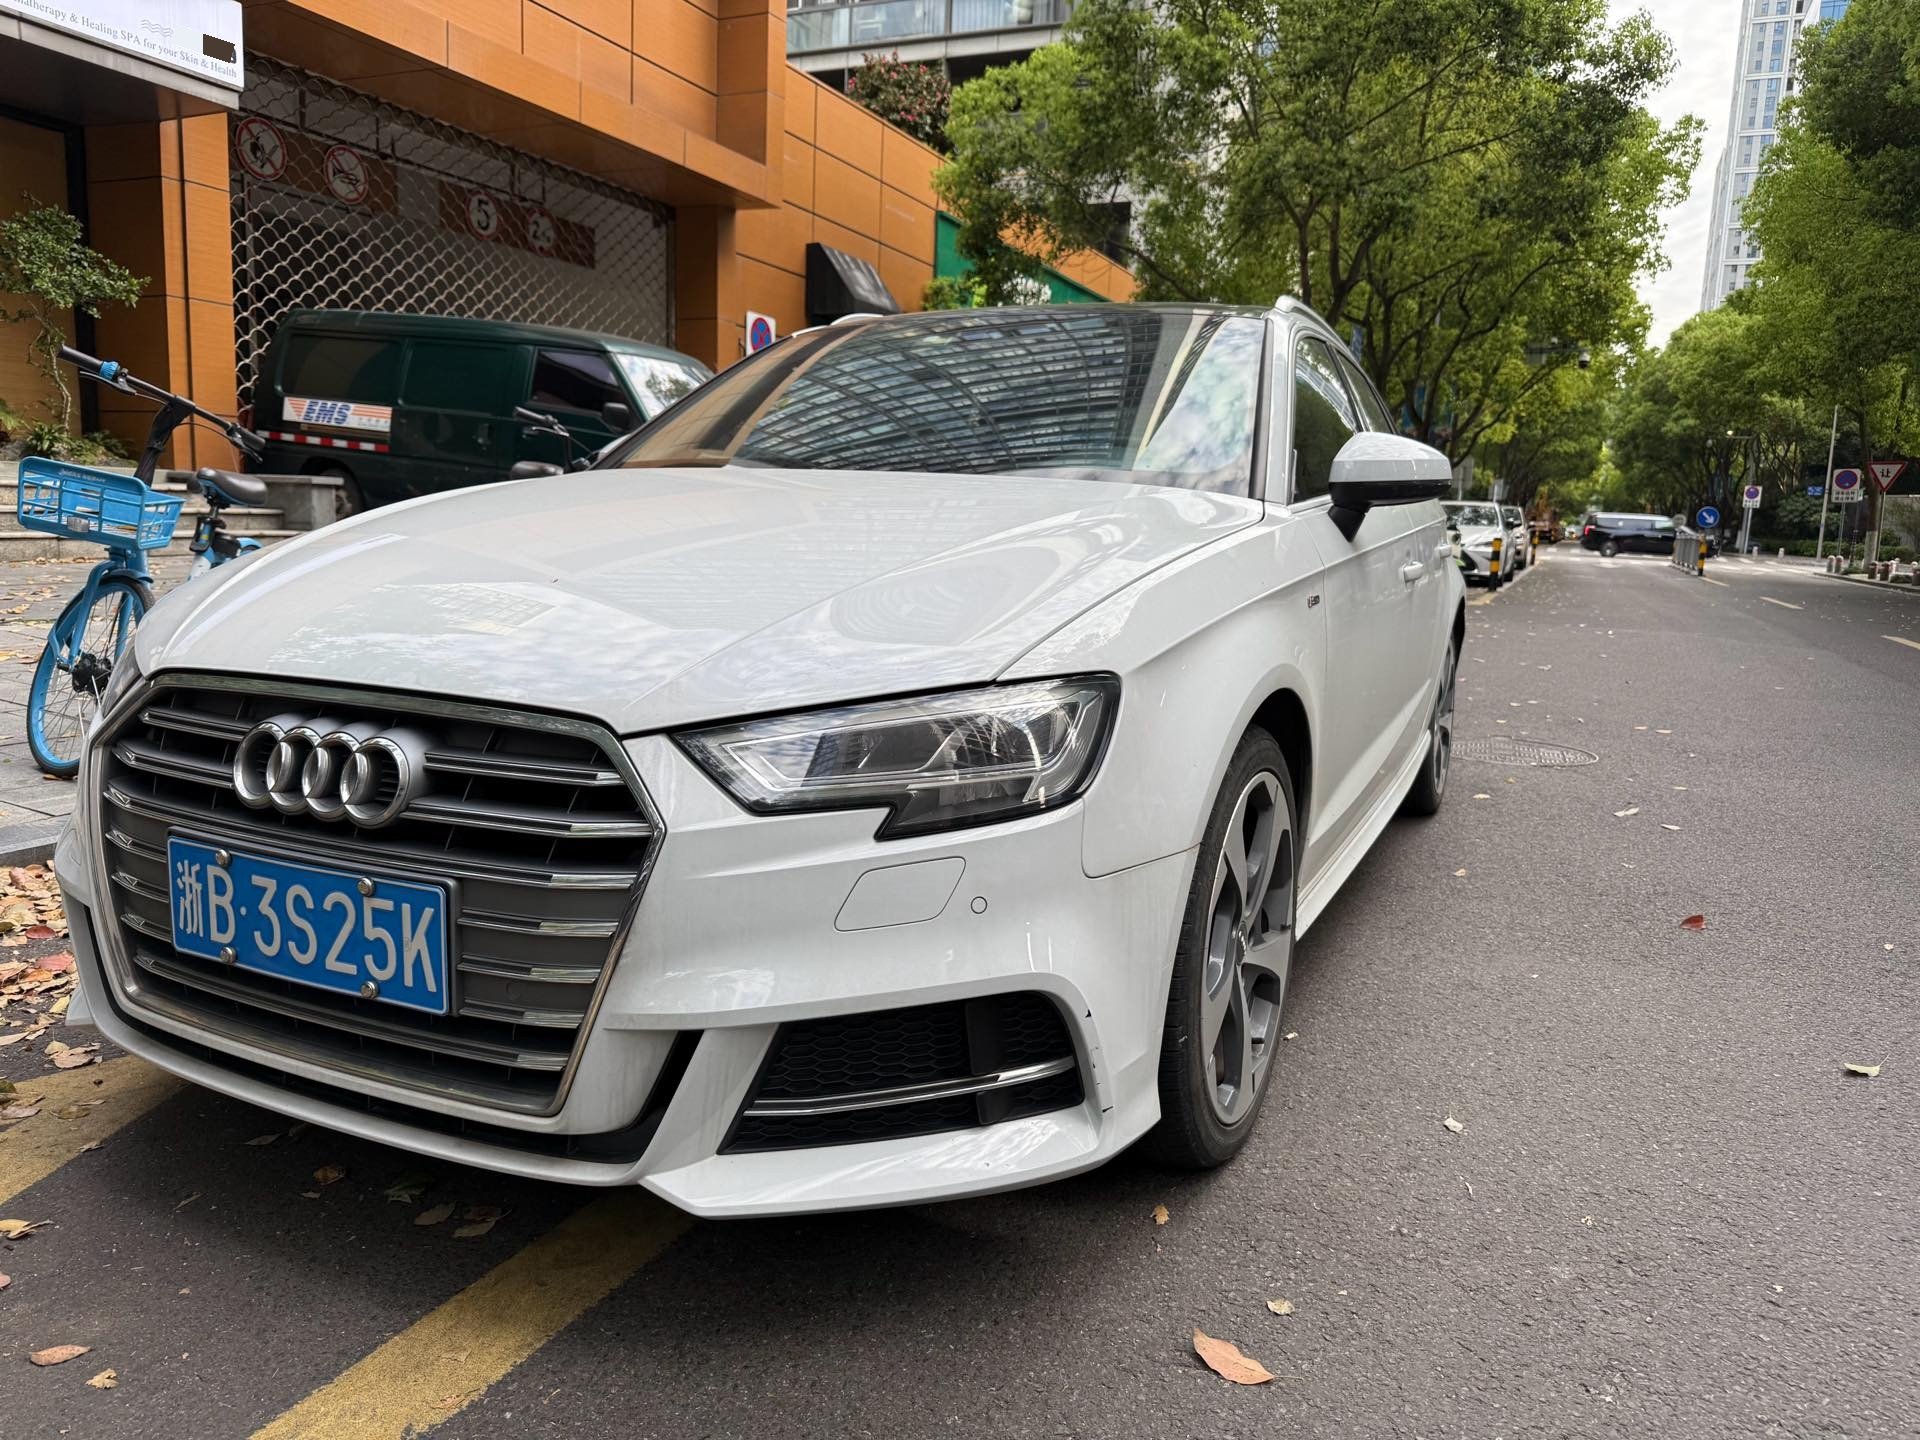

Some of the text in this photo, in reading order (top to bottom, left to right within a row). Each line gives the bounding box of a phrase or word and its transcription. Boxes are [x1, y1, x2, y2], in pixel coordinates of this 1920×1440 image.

[70, 13, 78, 23] &
[82, 16, 118, 39] Healing
[121, 30, 140, 45] SPA
[143, 38, 156, 49] for
[159, 45, 177, 57] your
[180, 51, 198, 65] Skin
[211, 61, 237, 78] Health
[477, 199, 490, 231] 5
[303, 400, 351, 425] EMS
[1880, 468, 1891, 478] 让
[176, 860, 438, 993] 浙B·3S25K
